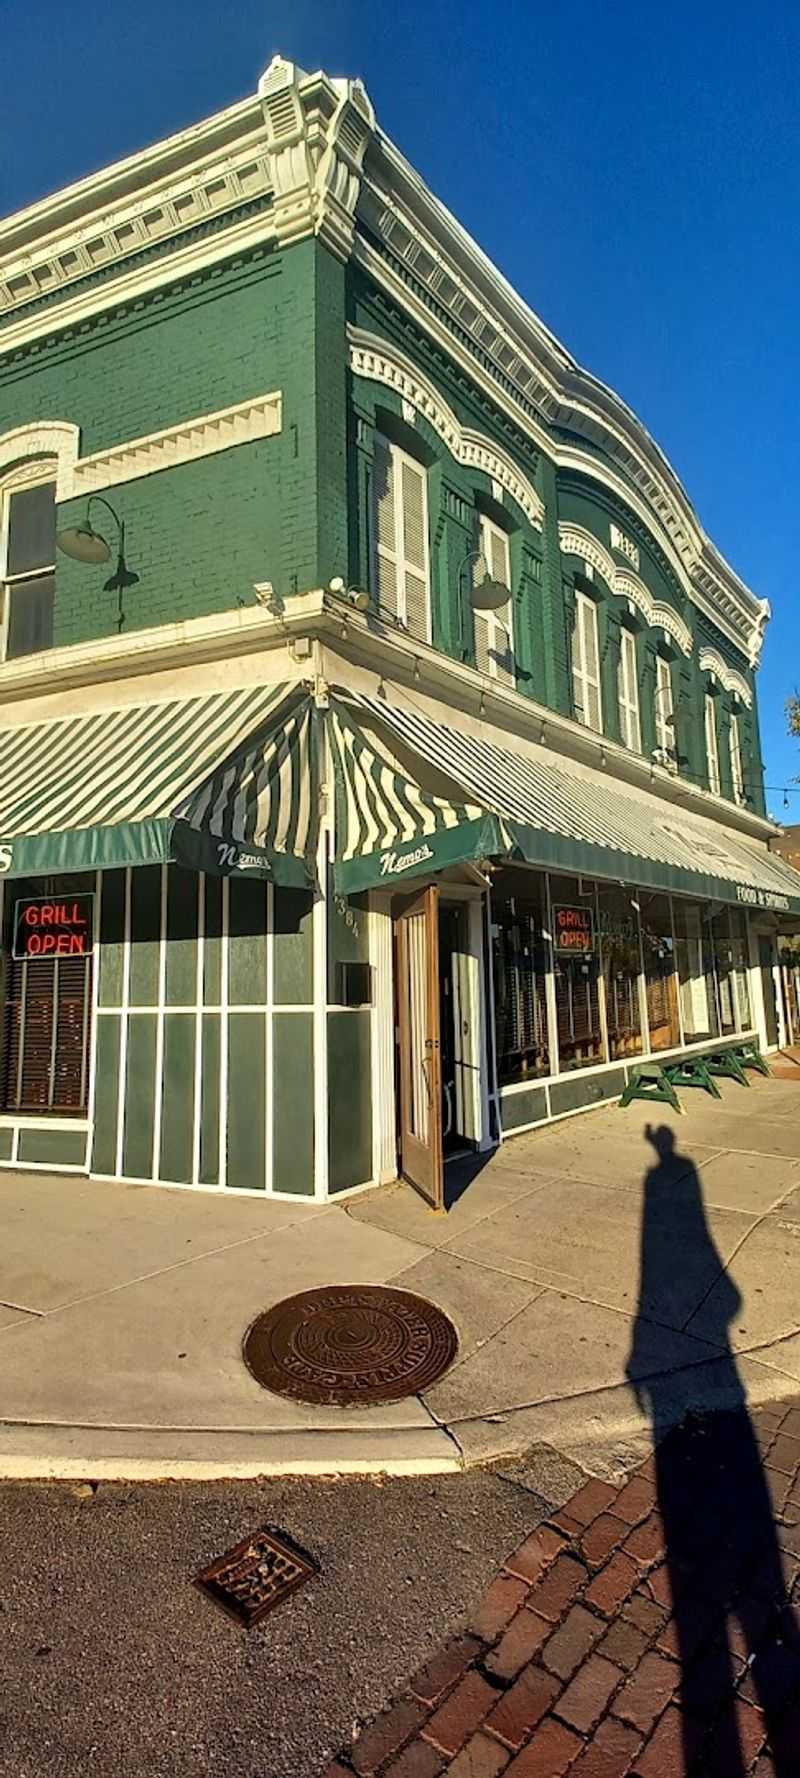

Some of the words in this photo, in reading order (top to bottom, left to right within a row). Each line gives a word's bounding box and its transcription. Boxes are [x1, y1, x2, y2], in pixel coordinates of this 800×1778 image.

[736, 885, 757, 904] FOOD
[25, 903, 86, 925] GRILL
[557, 910, 589, 928] GRILL
[27, 934, 84, 955] OPEN
[559, 931, 590, 948] OPEN
